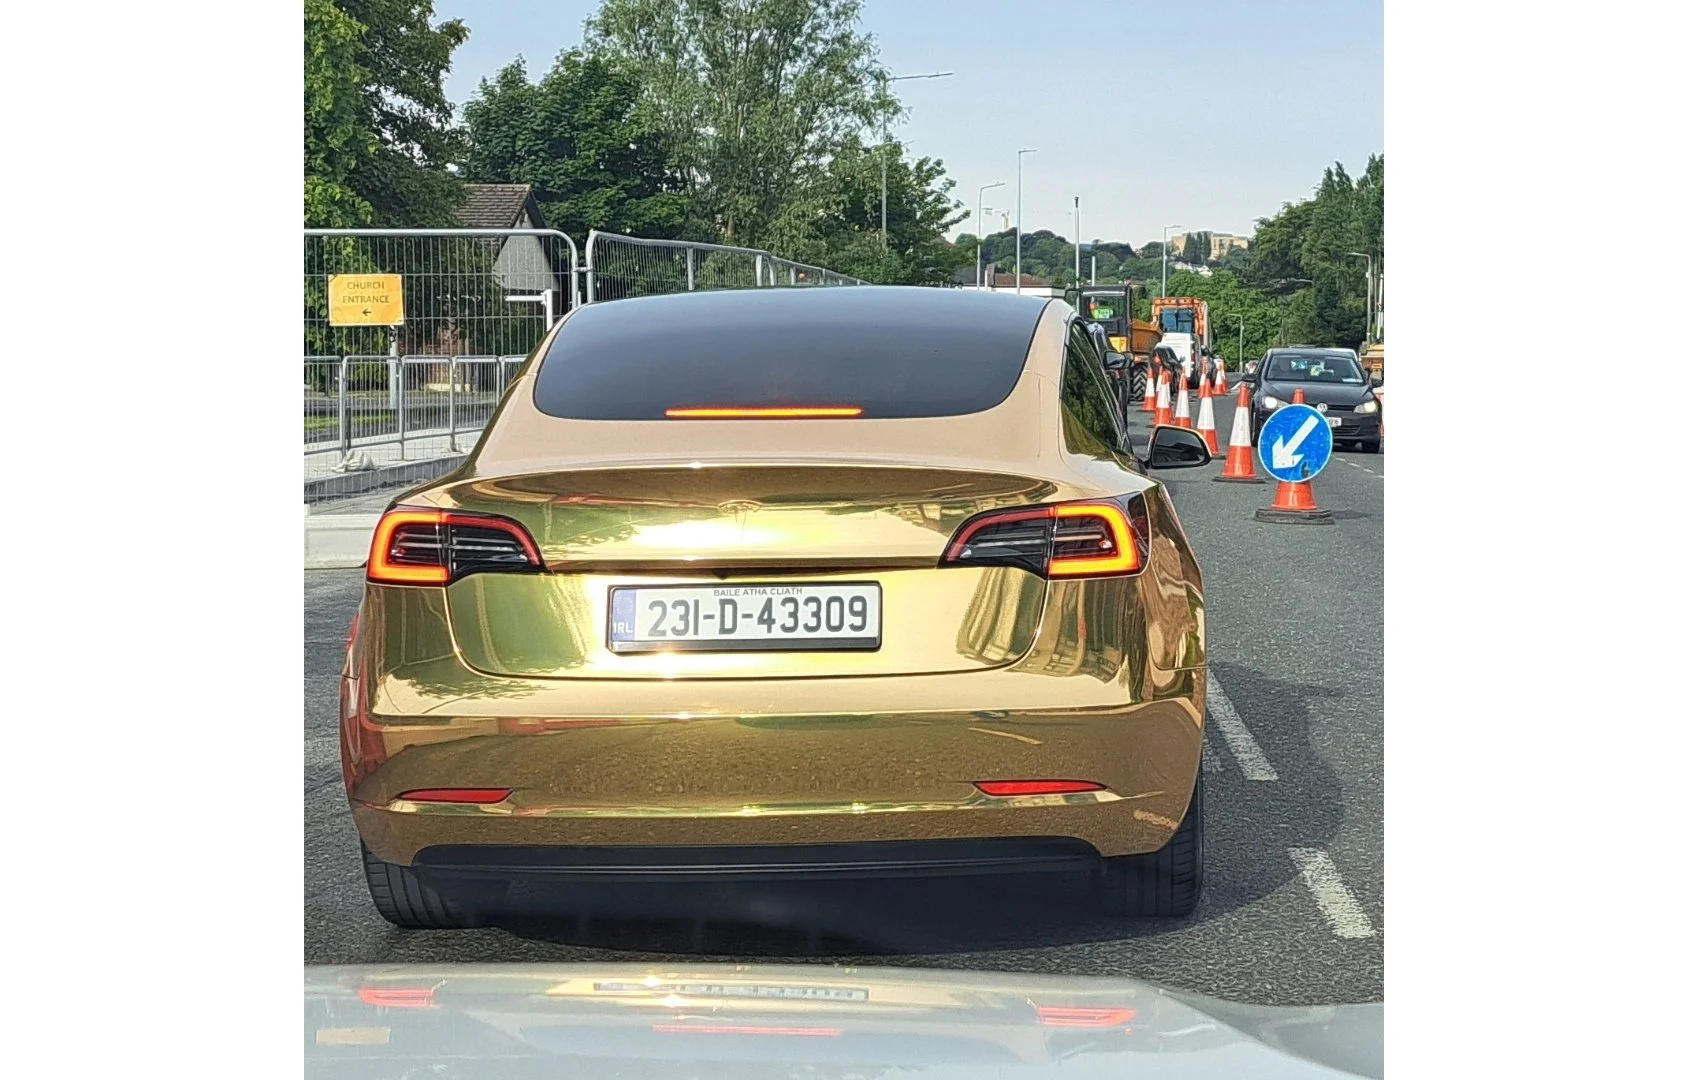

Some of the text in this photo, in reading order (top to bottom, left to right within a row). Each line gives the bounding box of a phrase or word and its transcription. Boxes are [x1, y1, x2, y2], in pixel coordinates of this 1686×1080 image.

[346, 281, 385, 290] CHURCH
[342, 295, 390, 304] ENTRANCE
[713, 589, 741, 597] BAILE
[769, 587, 803, 596] CLIATH
[648, 596, 868, 637] 231-D-43309
[613, 622, 634, 633] IRL
